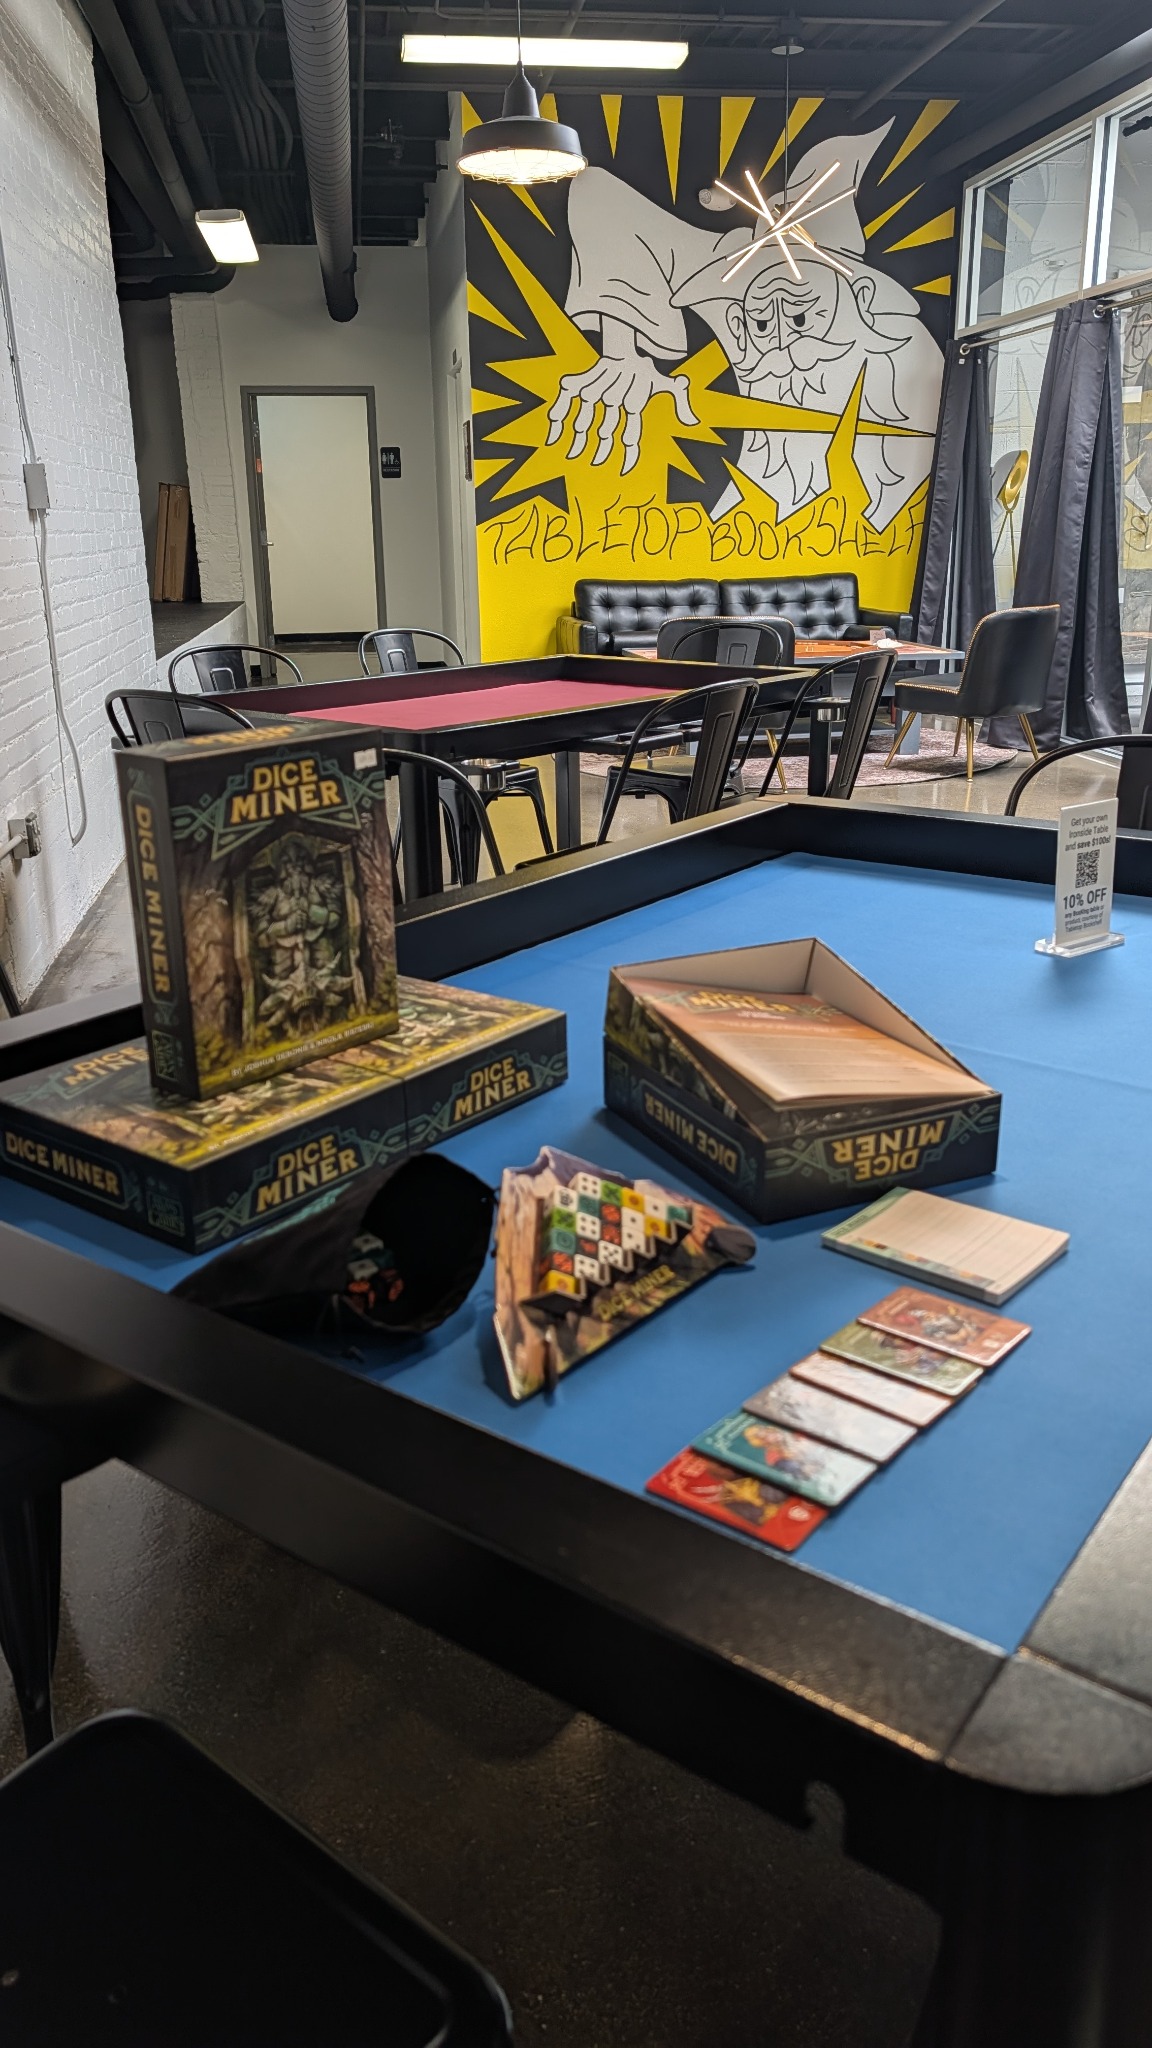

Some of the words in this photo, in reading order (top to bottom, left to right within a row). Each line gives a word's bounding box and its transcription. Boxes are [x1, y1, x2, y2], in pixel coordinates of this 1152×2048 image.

[484, 494, 703, 565] TABLETOP
[708, 490, 928, 562] BOOKSHELF
[253, 759, 318, 792] DICE
[230, 780, 341, 824] MINER
[1071, 818, 1081, 827] Get
[1082, 816, 1095, 827] your
[1096, 814, 1108, 823] own
[135, 804, 159, 882] DICE
[1065, 841, 1076, 851] and
[1077, 841, 1090, 849] save
[1069, 828, 1092, 838] Ironside
[1093, 825, 1109, 834] Table
[1063, 893, 1084, 910] 10%
[1087, 887, 1107, 904] OFF
[145, 889, 171, 993] MINER
[64, 1049, 149, 1085] MINE
[73, 1047, 136, 1072] DICE
[470, 1056, 515, 1092] DICE
[453, 1070, 532, 1122] MINER
[645, 1092, 696, 1145] MINER
[5, 1131, 49, 1168] DICE
[52, 1150, 120, 1195] MINER
[277, 1134, 336, 1178] DICE
[697, 1134, 738, 1174] DICE
[831, 1119, 945, 1164] MINER
[256, 1148, 359, 1213] MINER
[855, 1148, 919, 1180] DICE
[599, 1292, 632, 1321] DICE
[632, 1265, 676, 1298] MINER
